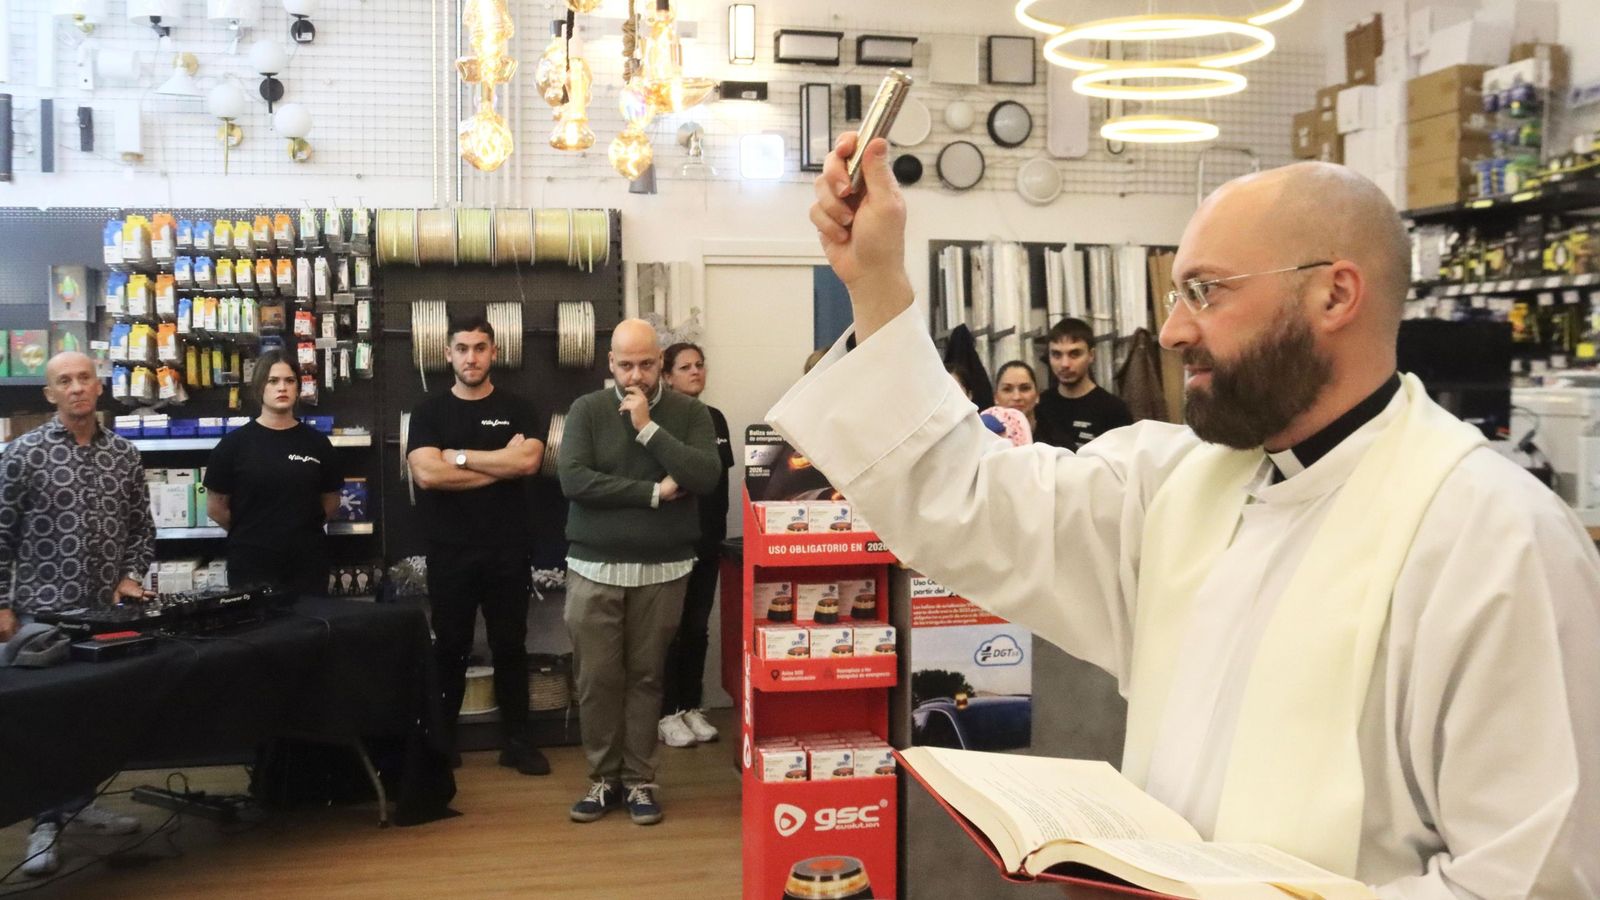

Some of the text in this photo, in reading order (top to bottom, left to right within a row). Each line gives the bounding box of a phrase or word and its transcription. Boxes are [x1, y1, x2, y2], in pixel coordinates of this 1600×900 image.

[768, 545, 787, 554] USO
[789, 543, 848, 553] OBLIGATORIO
[850, 542, 863, 552] EN
[993, 648, 1013, 658] DGT
[814, 805, 880, 832] gsc
